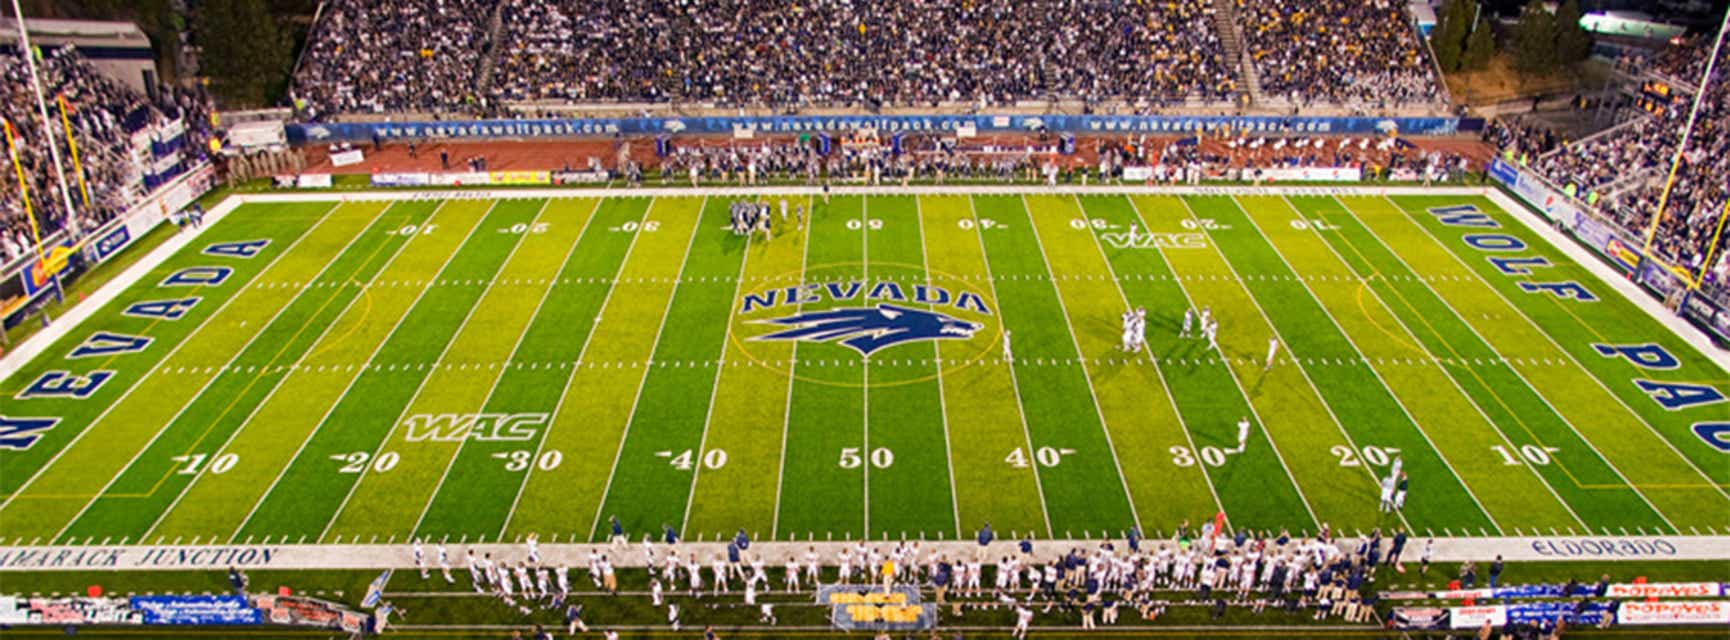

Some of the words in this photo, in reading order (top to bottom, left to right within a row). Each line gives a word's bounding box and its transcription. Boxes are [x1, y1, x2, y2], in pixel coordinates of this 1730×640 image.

[1090, 120, 1331, 132] www.nevadawolfpac.com
[1101, 232, 1206, 248] WAC
[1426, 204, 1600, 301] WOLF
[738, 281, 993, 316] NEVADA
[0, 238, 273, 451] NEVADA
[403, 412, 551, 442] WAC
[176, 453, 240, 475] 10
[337, 451, 401, 474] 20
[504, 450, 563, 472] 30
[669, 447, 728, 470] 40
[838, 447, 895, 469] 50
[1004, 446, 1062, 468] 40
[1169, 445, 1226, 467] 30
[1330, 445, 1389, 467] 20
[1491, 445, 1551, 467] 10
[134, 548, 278, 566] JUNCTION
[1532, 538, 1677, 557] ELDORADO
